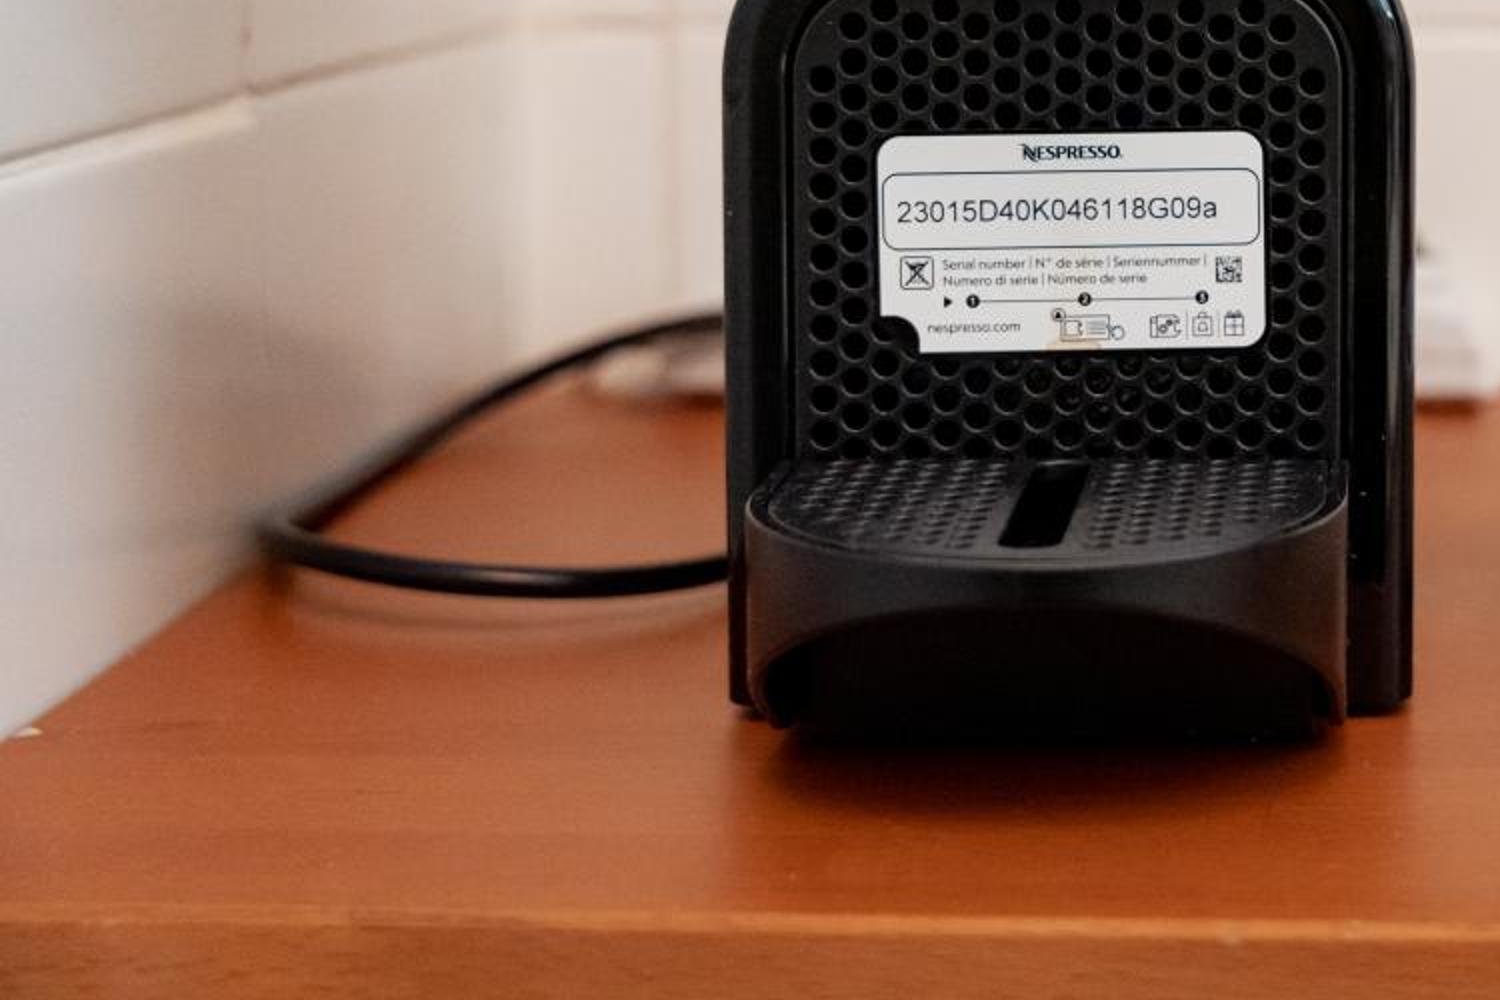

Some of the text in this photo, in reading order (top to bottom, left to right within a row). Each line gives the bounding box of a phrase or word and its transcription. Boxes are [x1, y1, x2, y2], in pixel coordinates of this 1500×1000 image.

[1021, 144, 1121, 162] NESPRESSO
[897, 196, 1217, 223] 23015D40K046118G09a
[943, 258, 976, 271] Serial
[979, 257, 1025, 270] number
[1056, 256, 1073, 269] de
[1113, 255, 1201, 268] Seriennummer
[995, 274, 1007, 286] di
[1099, 273, 1116, 284] de
[927, 322, 1021, 335] nespresso.com
